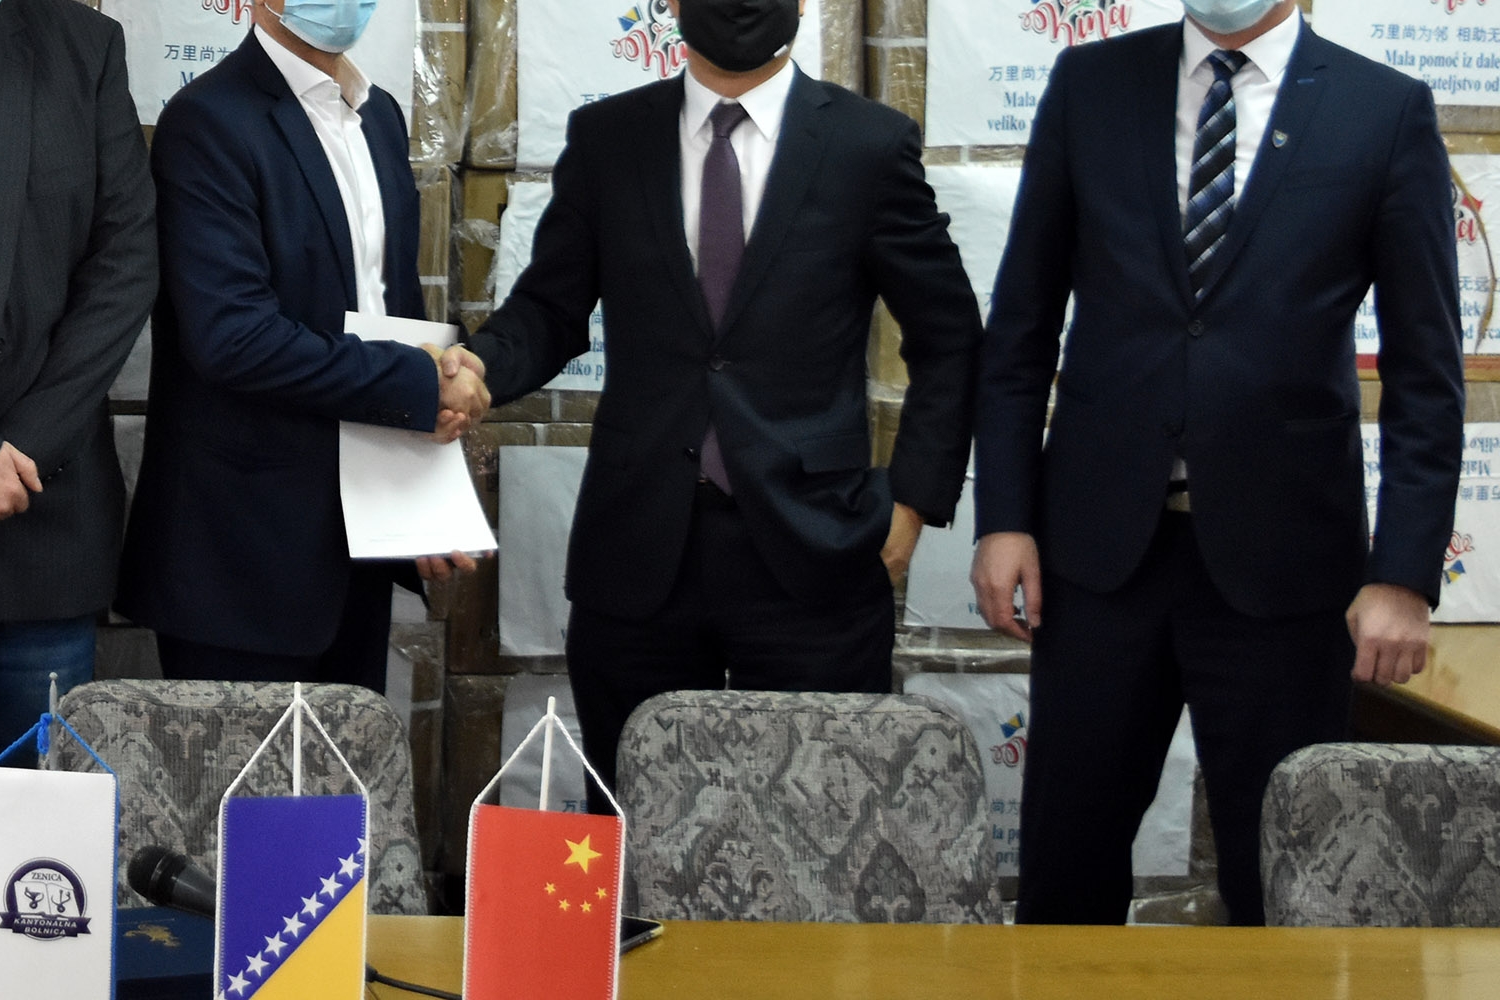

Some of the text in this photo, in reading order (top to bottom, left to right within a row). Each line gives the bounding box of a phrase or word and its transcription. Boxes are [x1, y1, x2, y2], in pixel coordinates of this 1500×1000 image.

[1383, 49, 1416, 67] Mala
[1462, 50, 1474, 69] iz
[1002, 90, 1036, 109] Mala
[986, 114, 1026, 132] veliko
[31, 872, 63, 883] ZENICA
[14, 917, 78, 929] KANTONALNA
[24, 927, 67, 936] BOLNICA
